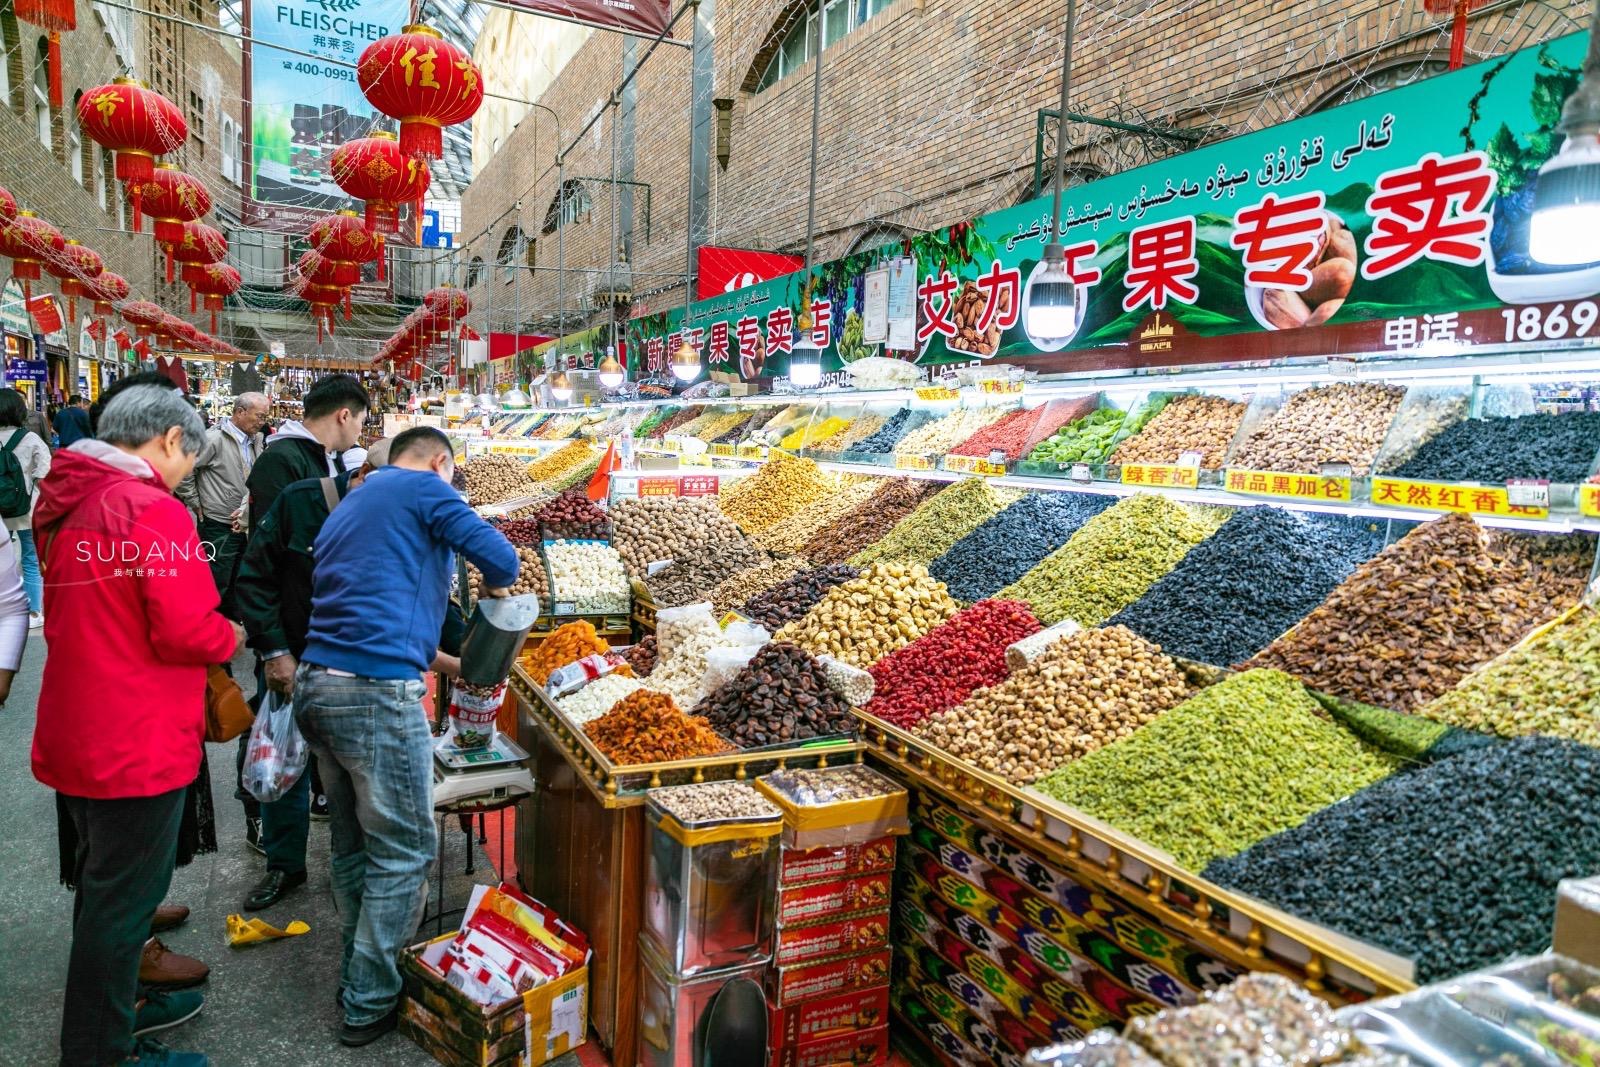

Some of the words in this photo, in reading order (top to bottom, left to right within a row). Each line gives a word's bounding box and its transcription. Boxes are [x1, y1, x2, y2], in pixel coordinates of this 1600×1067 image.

[277, 6, 389, 41] FLEISCHER
[1257, 135, 1324, 187] قۇرۇق
[1501, 301, 1599, 342] 1869
[1126, 467, 1194, 485] 绿香妃
[1230, 472, 1343, 499] 精品黑加仑
